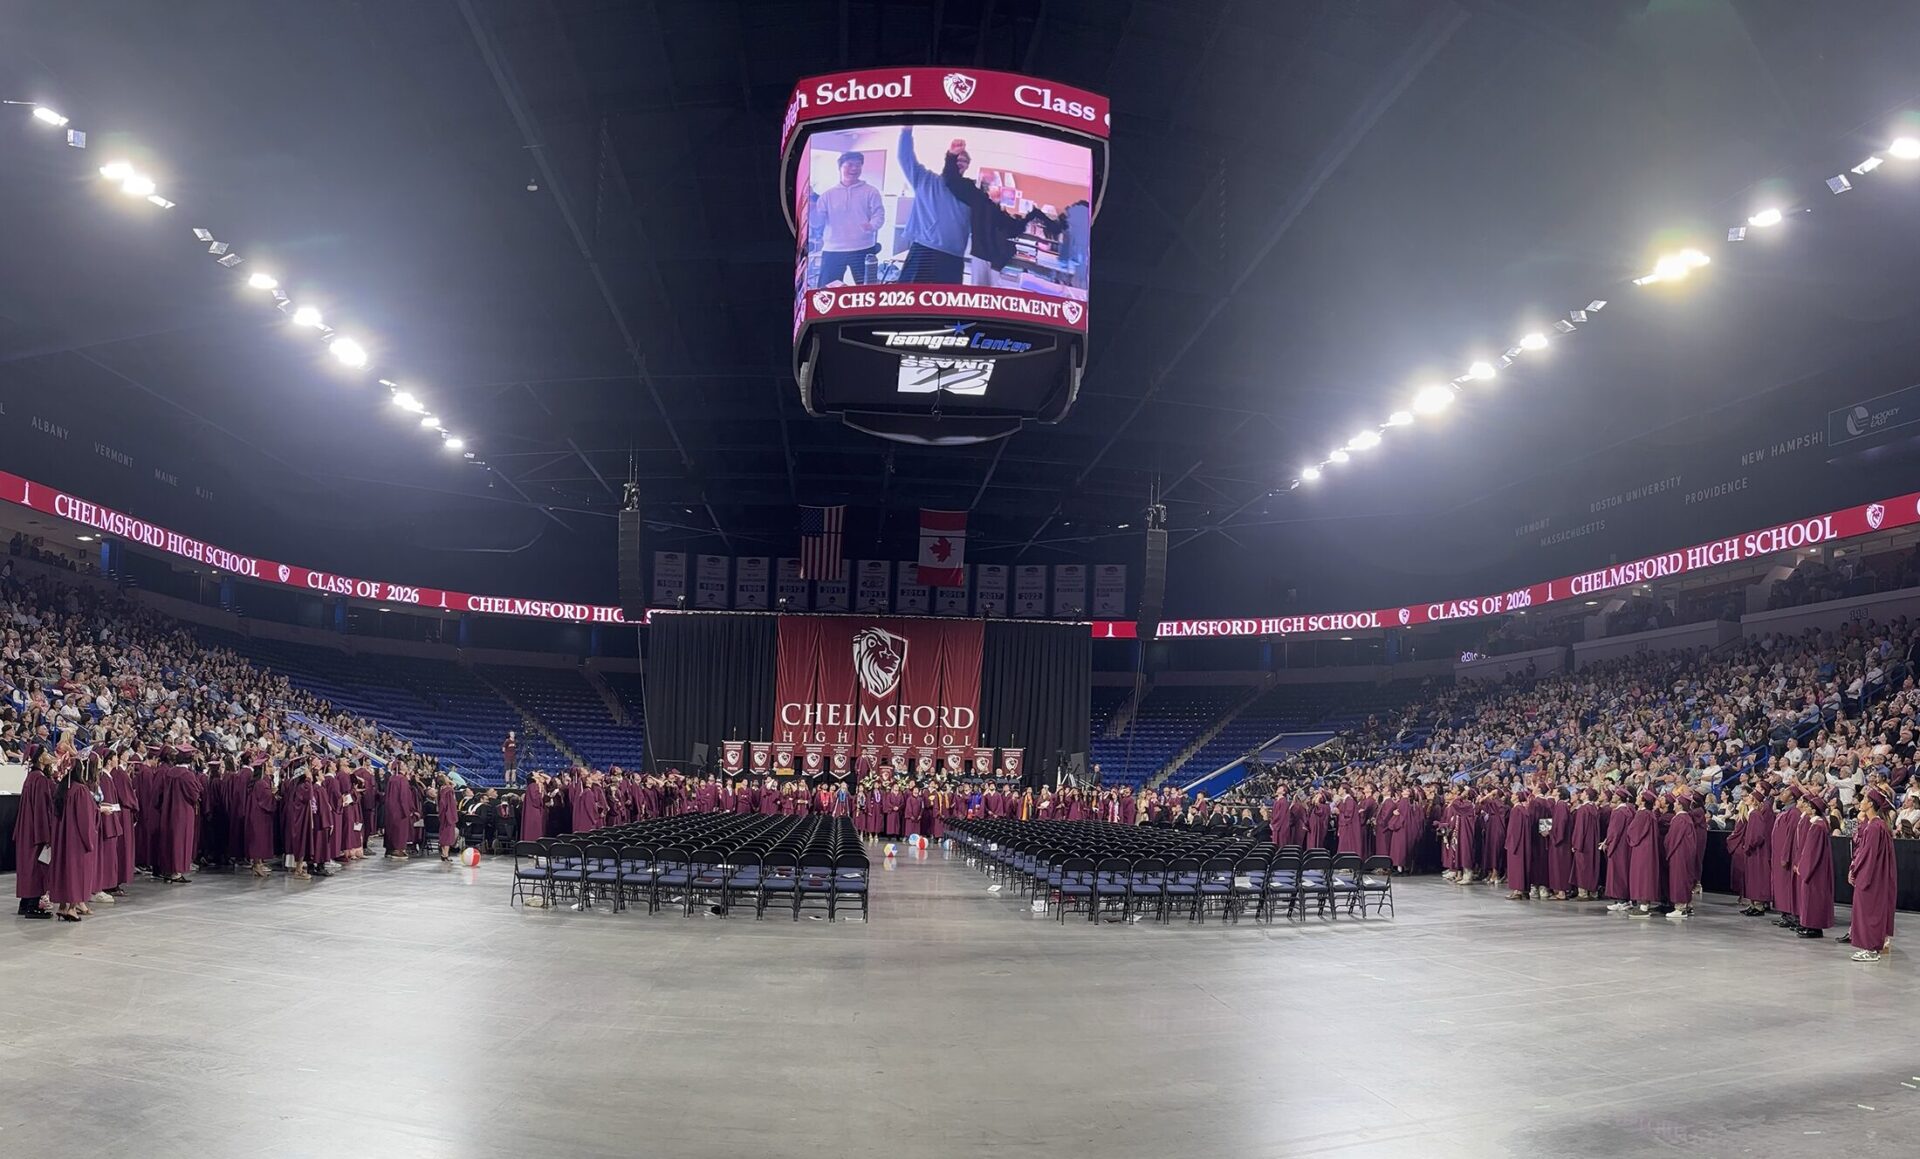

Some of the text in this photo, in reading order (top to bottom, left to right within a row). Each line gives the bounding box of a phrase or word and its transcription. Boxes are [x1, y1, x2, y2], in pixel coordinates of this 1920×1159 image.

[816, 75, 913, 105] School
[1014, 85, 1096, 121] Class
[838, 291, 1062, 318] CHS 2026 COMMENCEMENT
[885, 332, 1032, 353] Tsongas Center
[32, 416, 69, 440] ALBANY
[1870, 417, 1887, 428] EAST
[1871, 408, 1900, 421] HOCKEY
[94, 441, 134, 468] VERMONT
[1741, 448, 1765, 466] NEW
[154, 468, 178, 487] MAINE
[1685, 477, 1748, 505] PROVIDENCE
[1590, 475, 1681, 513] BOSTON UNIVERSITY
[54, 493, 260, 578] CHELMSFORD HIGH SCHOOL
[1514, 518, 1550, 537] VERMONT
[1540, 519, 1606, 547] MASSACHUSETTS
[1570, 516, 1838, 595] CHELMSFORD HIGH SCHOOL
[307, 571, 420, 604] CLASS OF 2026
[467, 595, 589, 621] CHELMSFORD
[592, 607, 625, 623] HIG
[1427, 588, 1531, 621] CLASS OF 2026
[1260, 617, 1305, 634] HIGH
[1308, 612, 1381, 631] SCHOOL
[781, 703, 975, 729] CHELMSFORD
[782, 731, 972, 747] HIGH SCHOOL
